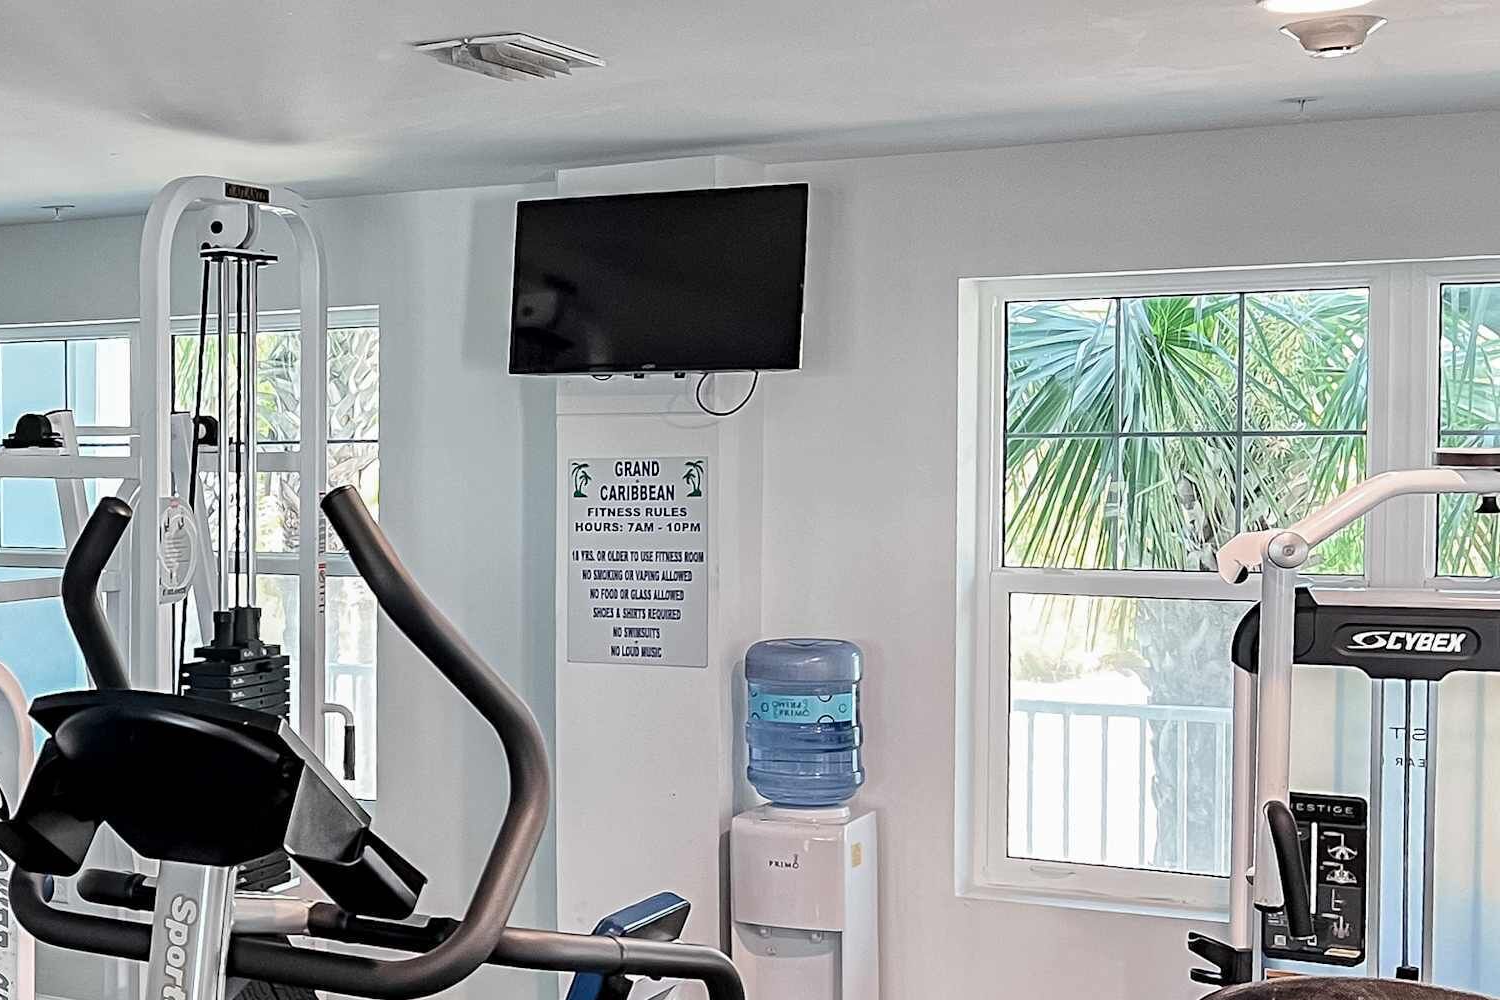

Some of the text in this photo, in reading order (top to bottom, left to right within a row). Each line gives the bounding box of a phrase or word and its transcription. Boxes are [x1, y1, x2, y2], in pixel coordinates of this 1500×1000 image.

[615, 461, 660, 477] GRAND
[600, 485, 675, 501] CARIBBEAN
[587, 507, 688, 517] FITNESS RULES
[575, 522, 623, 532] HOURS:
[628, 522, 654, 532] 7AM
[666, 522, 701, 532] 10PM
[597, 551, 606, 561] OR
[608, 551, 629, 562] OLDER
[631, 551, 639, 561] TO
[640, 551, 653, 562] USE
[655, 551, 682, 562] FITNESS
[684, 552, 704, 562] ROOM
[582, 569, 693, 581] NO SMOKING OR VAPING ALLOWED
[590, 588, 684, 600] NO FOOD OR GLASS ALLOWED
[593, 607, 614, 618] SHOES
[622, 608, 646, 619] SHIRTS
[648, 608, 681, 620] REQUIRED
[613, 626, 660, 639] NO SWIMSUITS
[1386, 631, 1466, 653] CYBEX
[611, 645, 662, 658] NO LOUD MUSIC
[1291, 802, 1354, 815] ESTIGE
[769, 858, 800, 869] PRIMO
